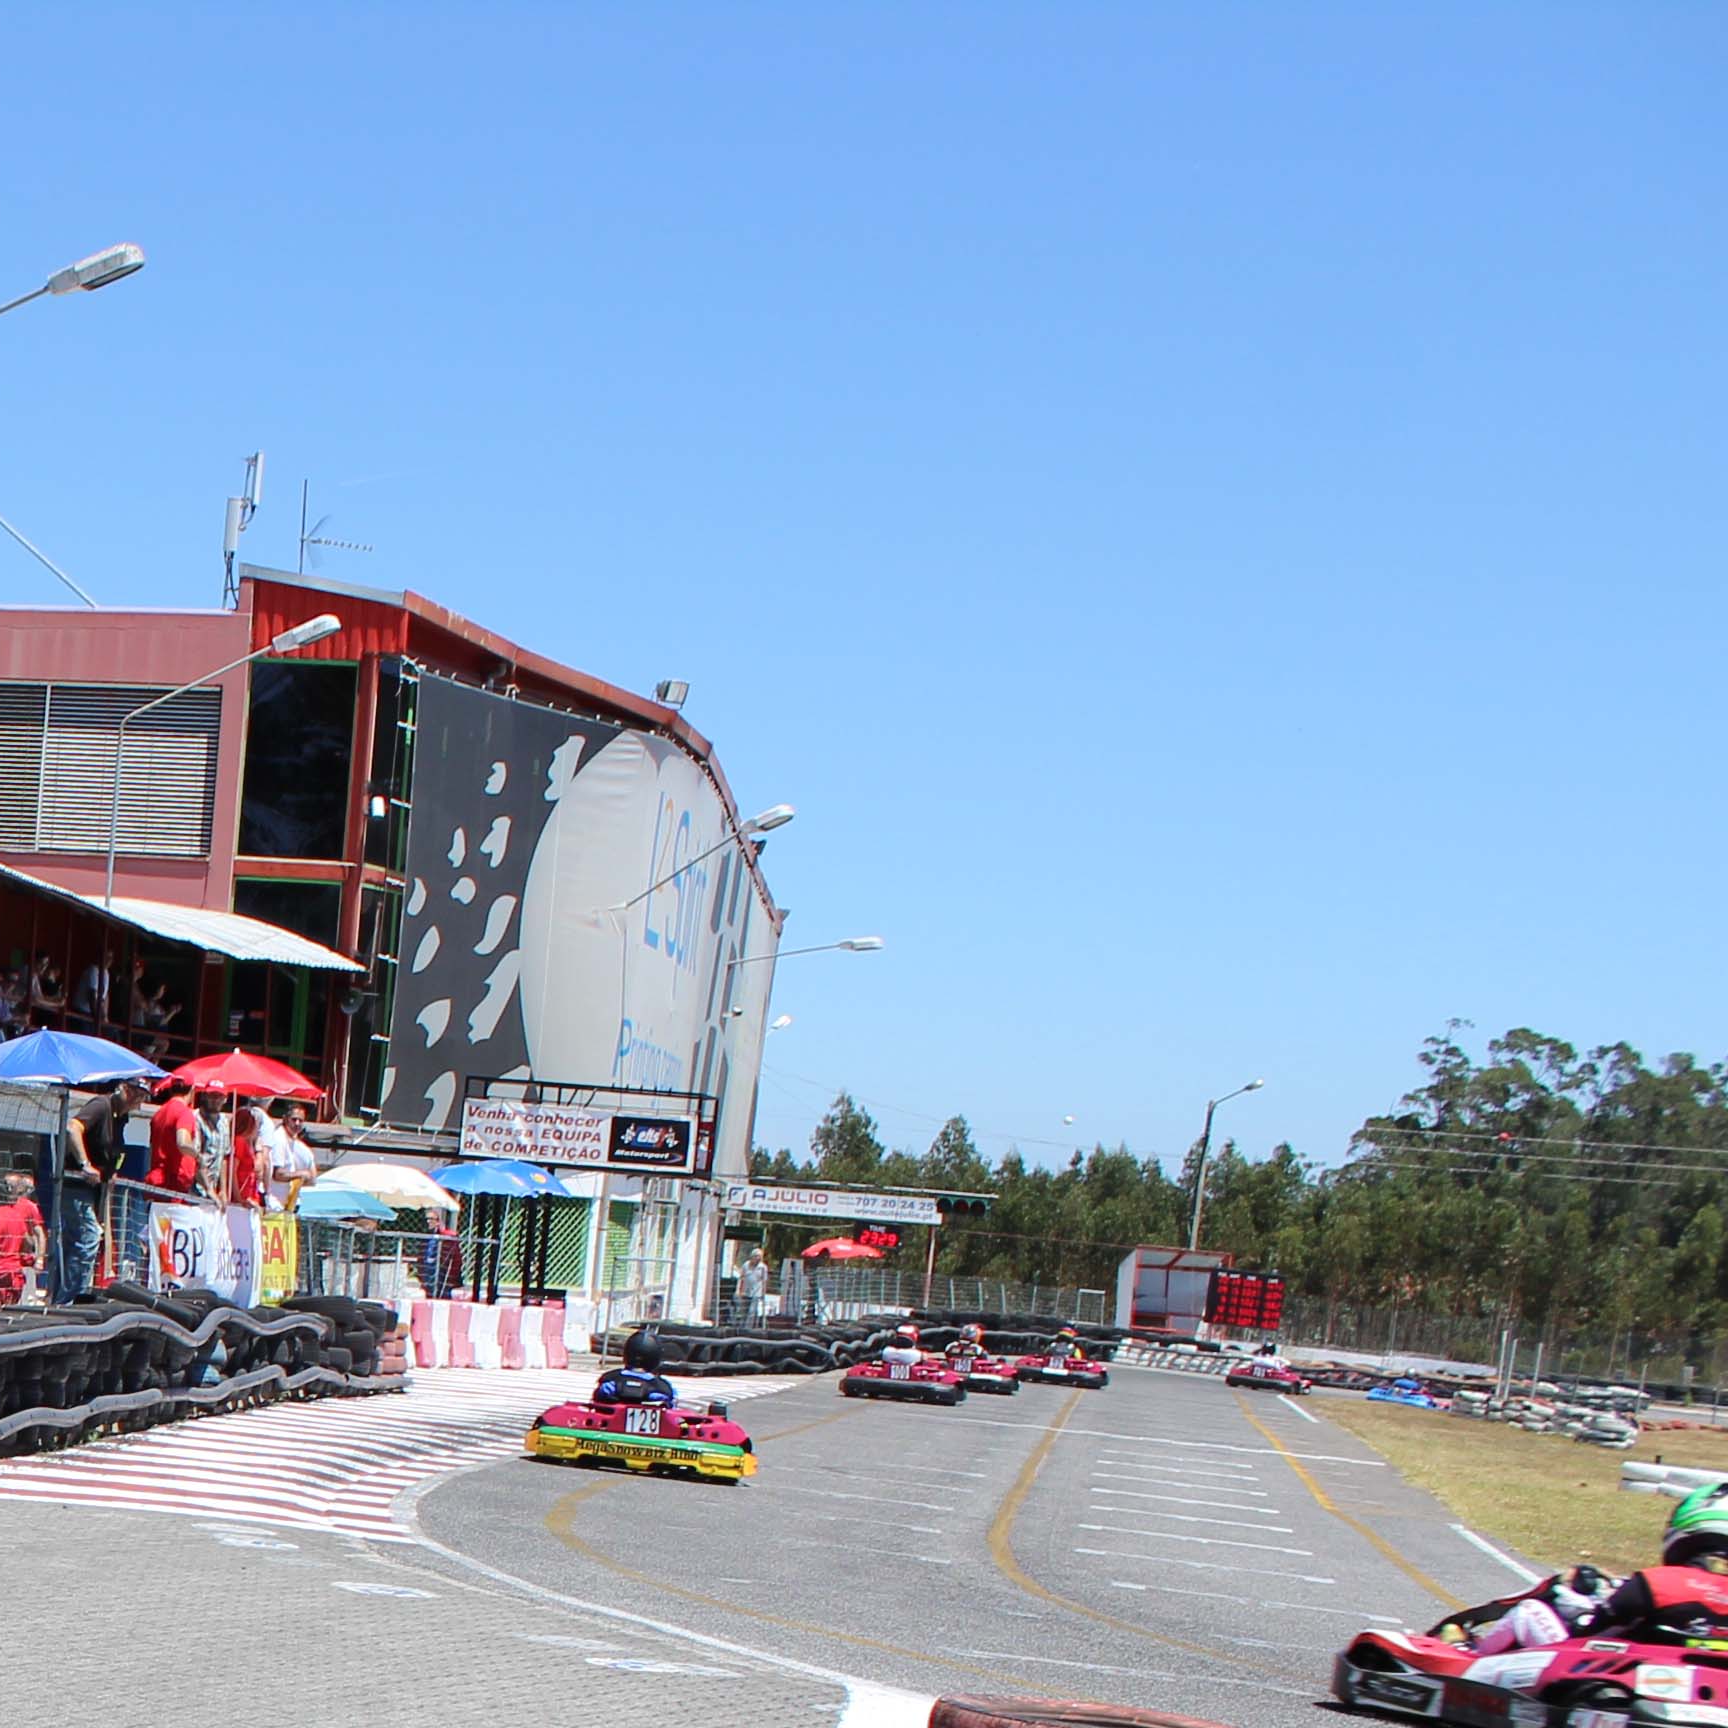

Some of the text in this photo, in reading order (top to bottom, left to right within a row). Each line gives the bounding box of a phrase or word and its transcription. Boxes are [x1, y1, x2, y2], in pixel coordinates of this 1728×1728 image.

[467, 1105, 604, 1128] Venha conhecer
[467, 1124, 601, 1143] a nossa EQUIPA
[463, 1139, 483, 1150] de
[855, 1197, 878, 1207] 707
[880, 1199, 897, 1209] 20
[900, 1200, 916, 1210] 24
[919, 1202, 935, 1211] 25
[628, 1409, 659, 1434] 128
